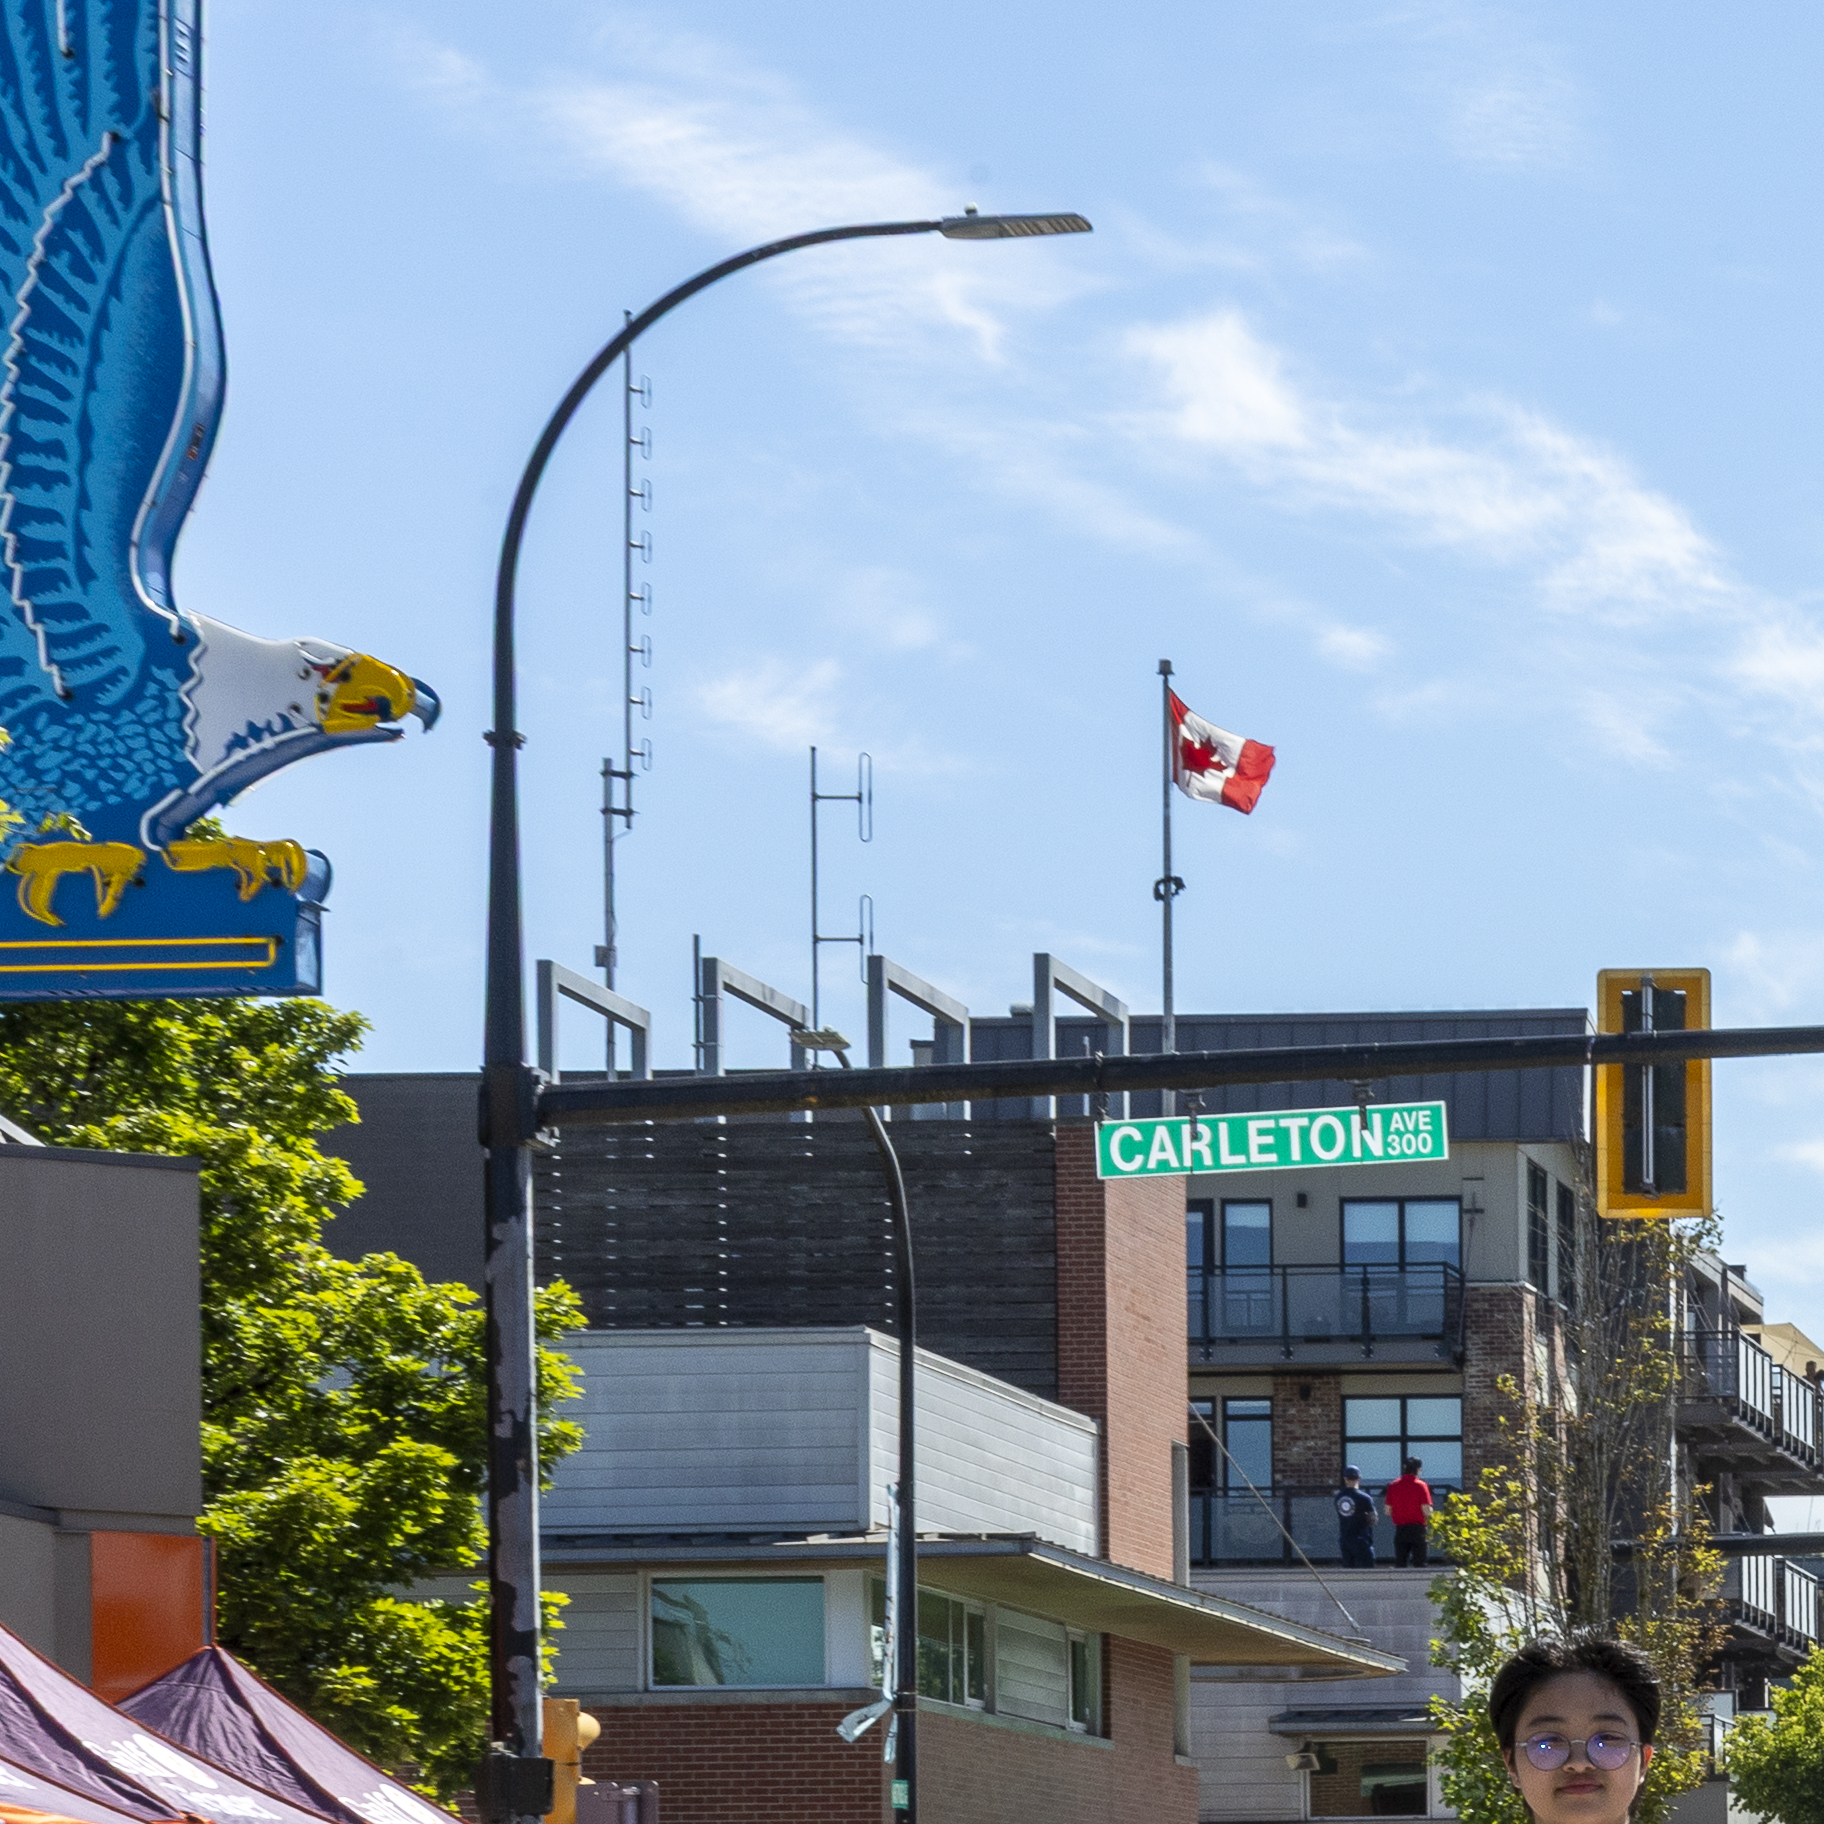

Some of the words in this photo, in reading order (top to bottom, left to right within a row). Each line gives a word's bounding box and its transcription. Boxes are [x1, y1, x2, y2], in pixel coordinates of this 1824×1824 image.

[1389, 1110, 1432, 1133] AVE
[1109, 1112, 1384, 1172] CARLETON
[1387, 1133, 1432, 1156] 300
